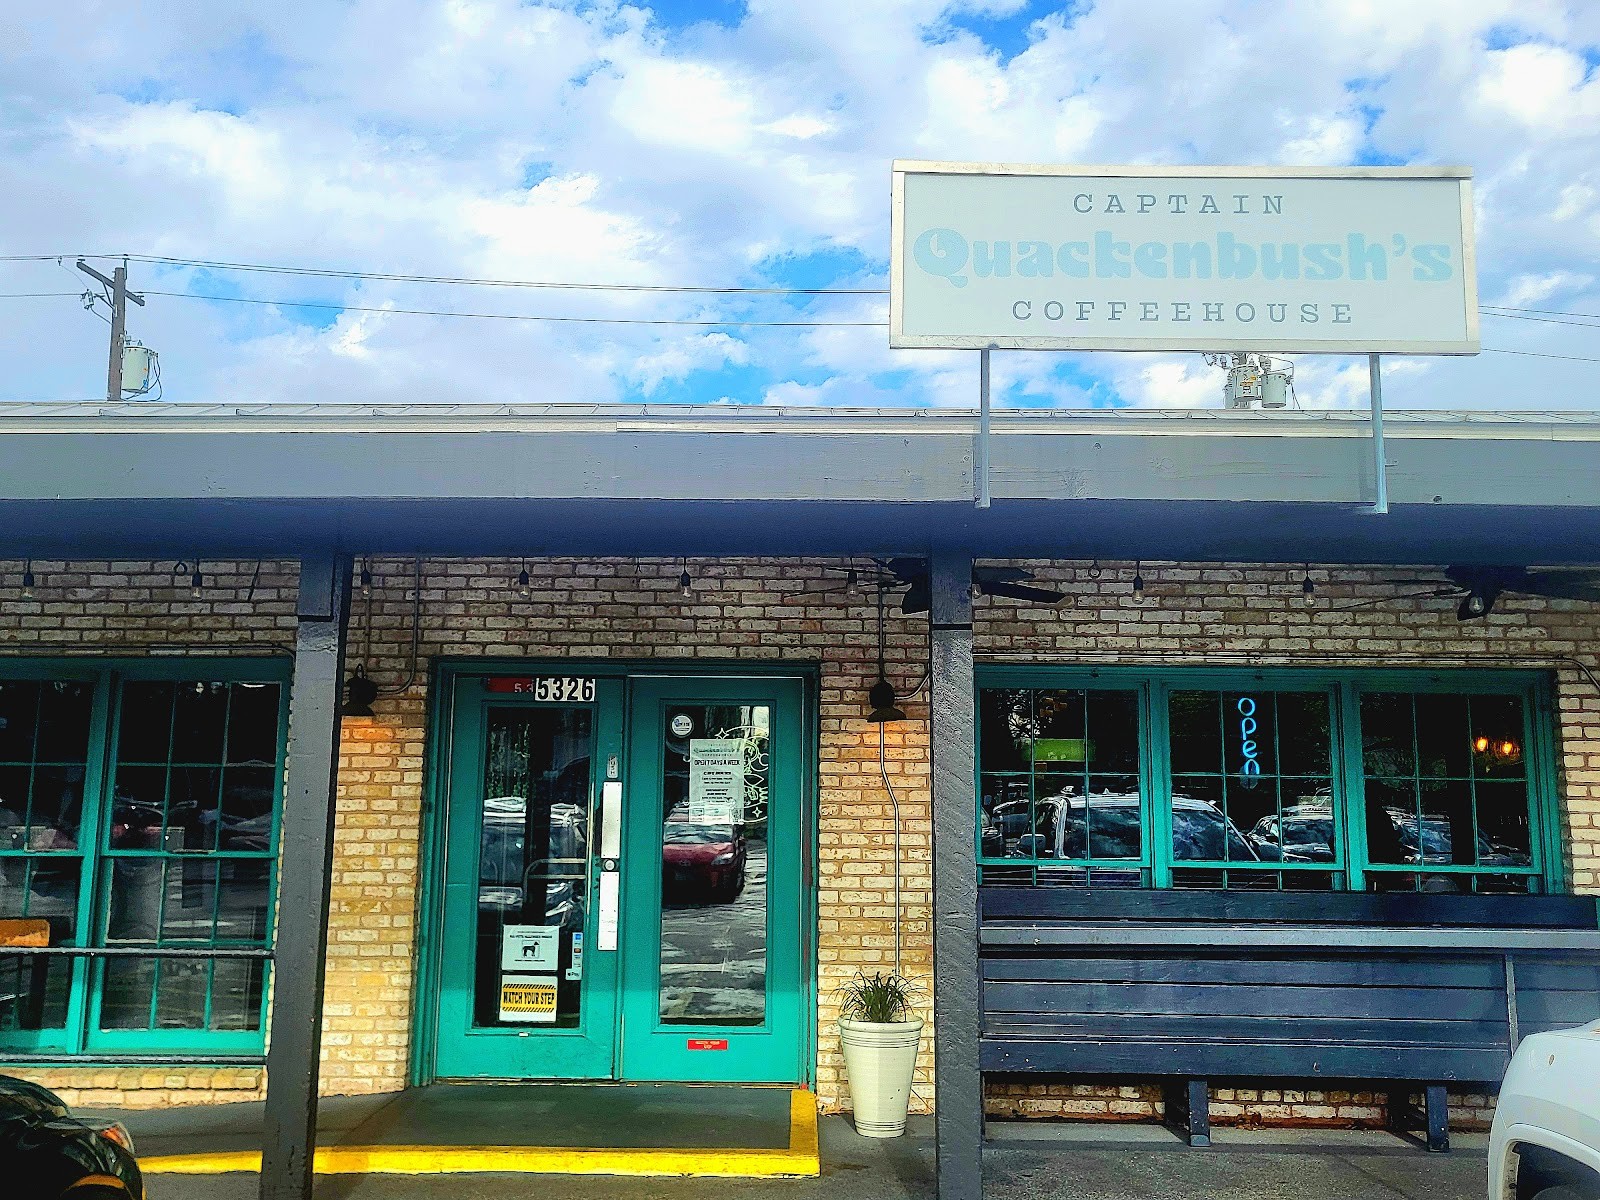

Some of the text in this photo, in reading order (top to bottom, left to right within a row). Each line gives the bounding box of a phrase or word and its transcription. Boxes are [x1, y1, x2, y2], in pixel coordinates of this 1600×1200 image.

[1073, 193, 1284, 216] CAPTAIN
[912, 227, 1453, 288] Quackenbush's
[1012, 300, 1353, 325] COFFEEHOUSE
[537, 680, 594, 700] 5326
[503, 992, 555, 1005] WATCH YOUR STEP
